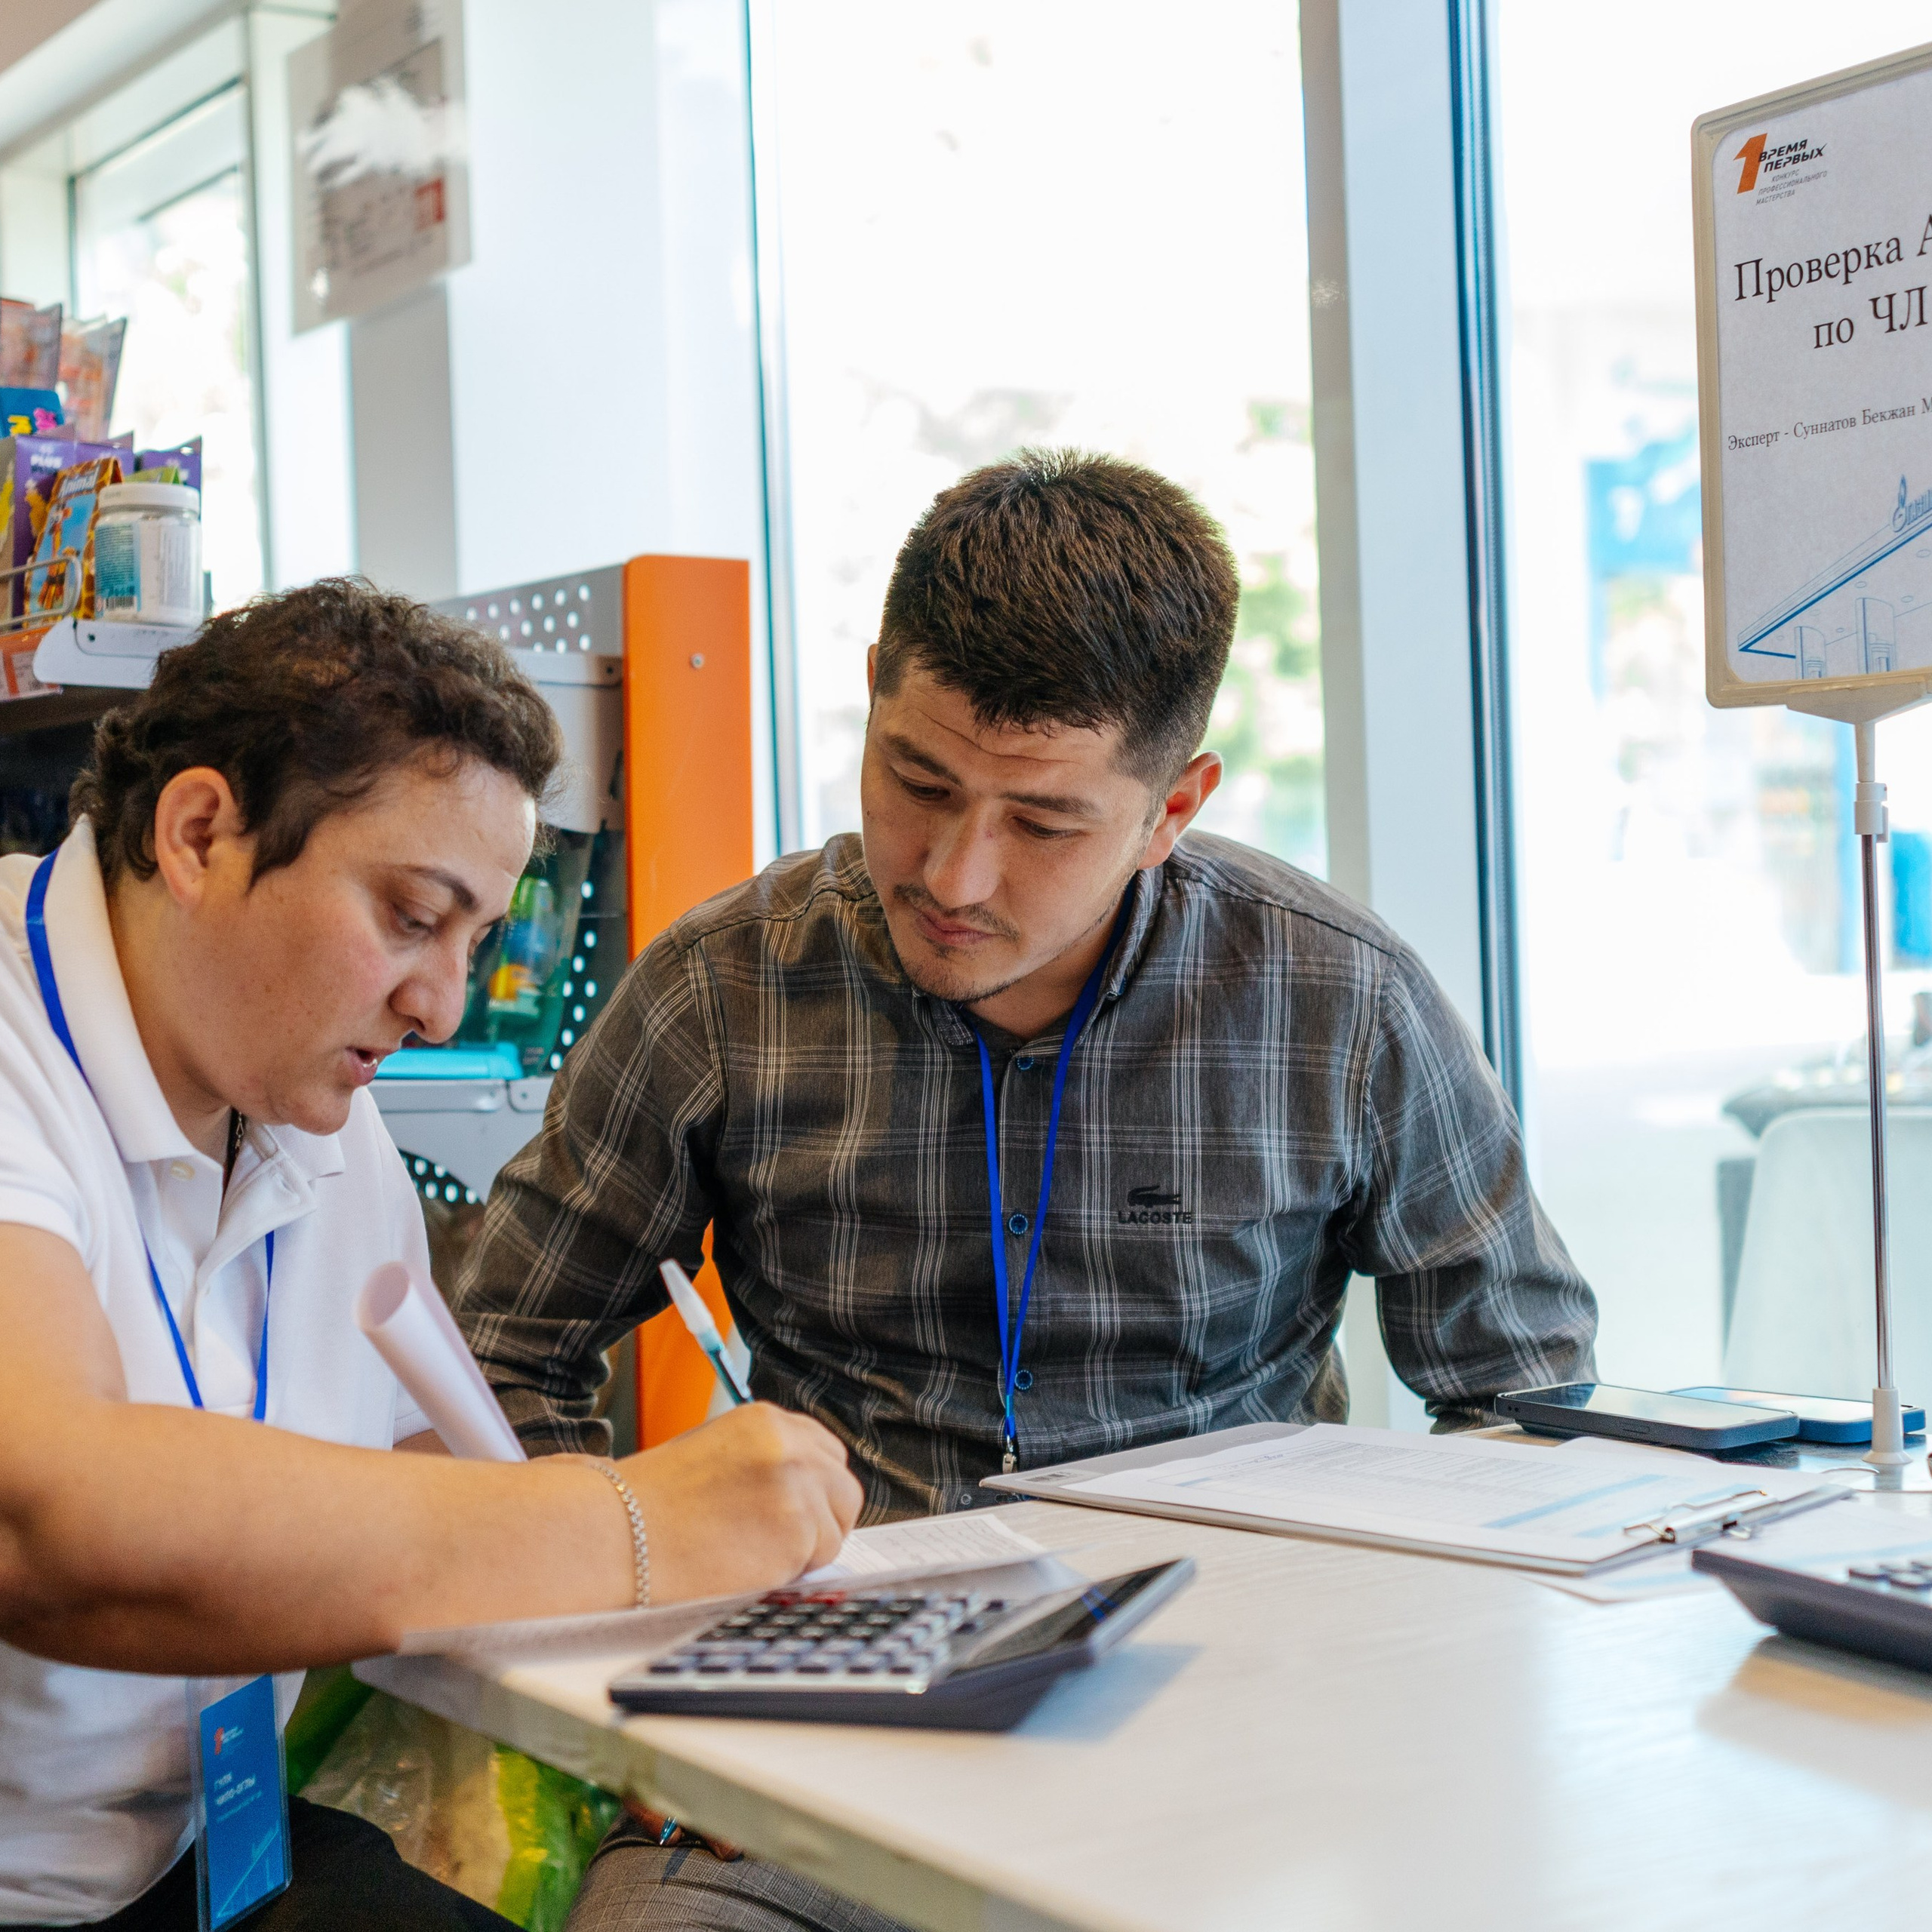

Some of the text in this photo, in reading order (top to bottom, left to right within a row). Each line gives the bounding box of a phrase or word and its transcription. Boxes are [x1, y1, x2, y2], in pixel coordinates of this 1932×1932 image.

[1758, 139, 1808, 163] ВРЕМЯ
[1764, 143, 1827, 174] ПЕРВЫХ
[1758, 171, 1828, 196] ПРОФЕССИОНАЛЬНОГО
[1771, 169, 1800, 183] КОНКУРС
[1755, 189, 1795, 205] МАСТЕРСТВА
[1734, 237, 1904, 303] Проверка
[1814, 317, 1854, 349] по
[1727, 431, 1780, 451] Эксперт
[1793, 416, 1857, 440] Суннатов
[1861, 406, 1915, 426] Бекжан
[1117, 1210, 1192, 1224] LACOSTE
